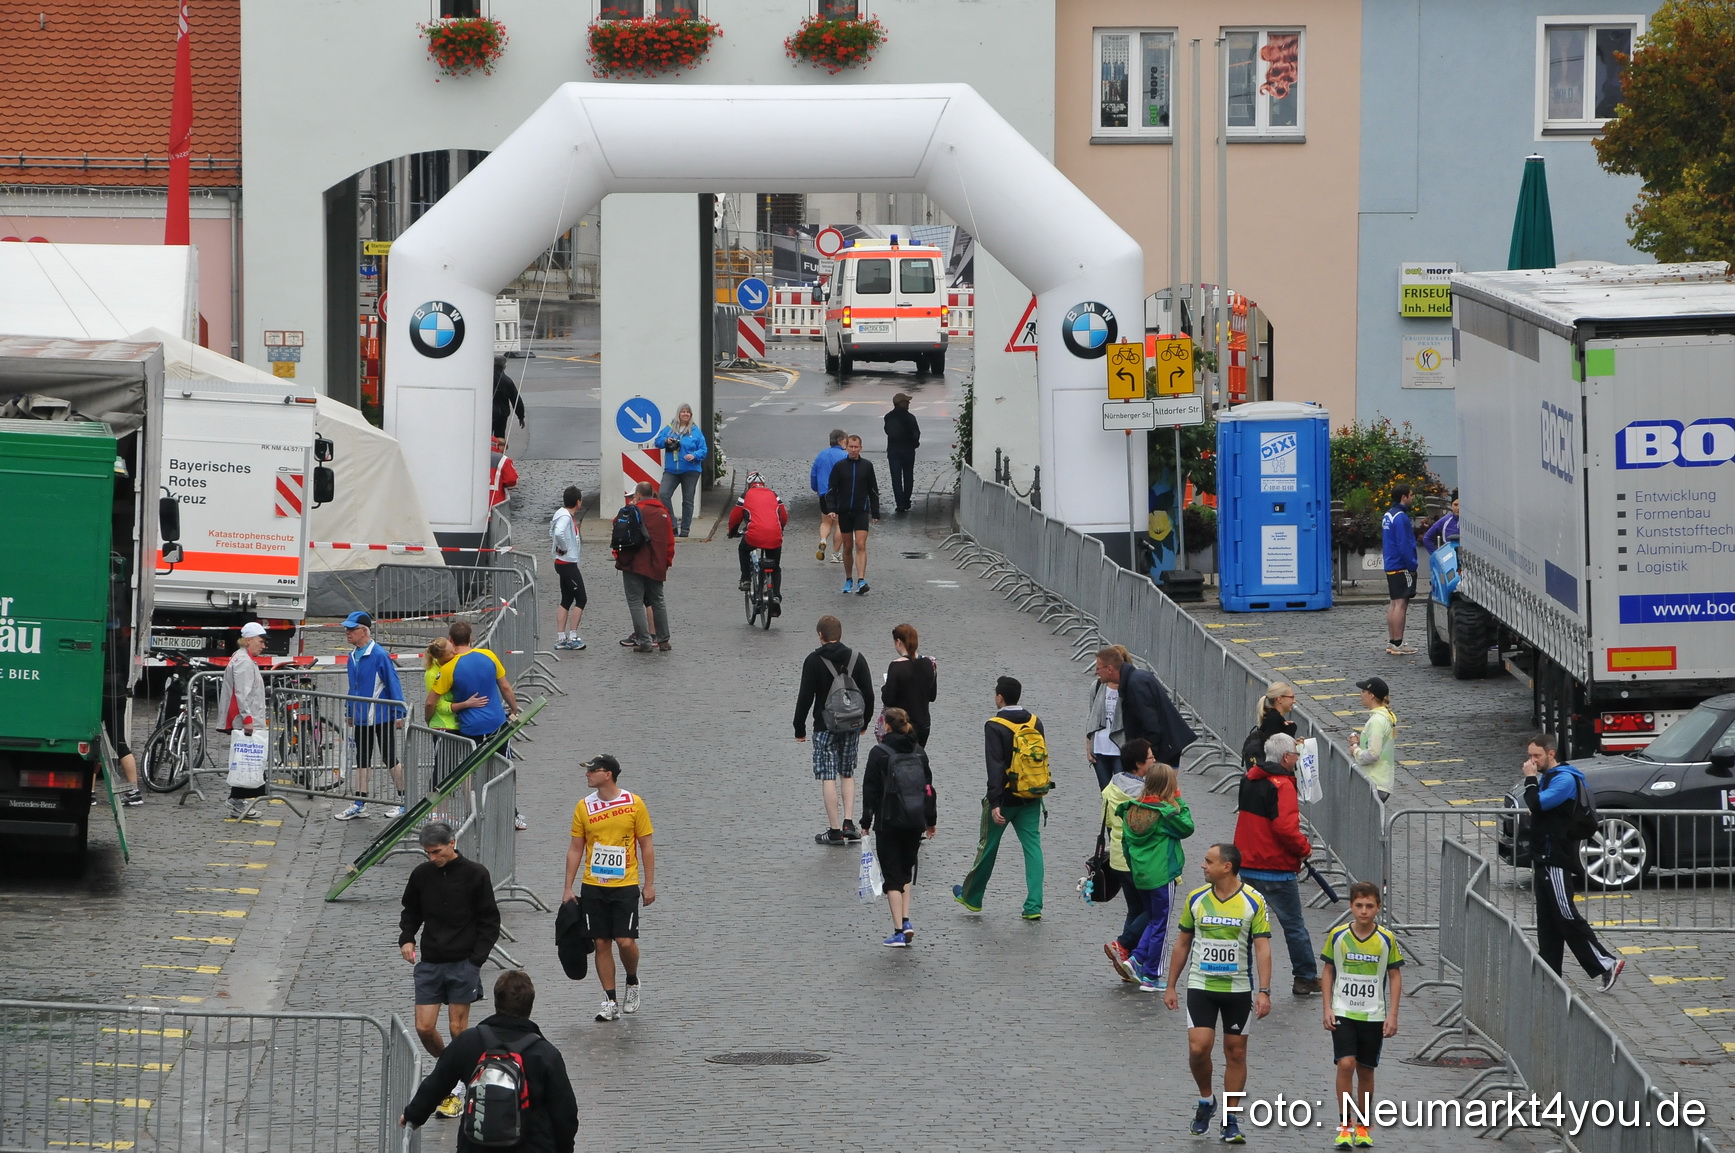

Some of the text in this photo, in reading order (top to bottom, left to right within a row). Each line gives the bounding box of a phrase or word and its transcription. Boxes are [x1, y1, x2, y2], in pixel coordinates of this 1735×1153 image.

[1149, 105, 1158, 125] cut
[1405, 267, 1423, 275] cut
[415, 301, 461, 322] BMW
[1067, 302, 1113, 322] BMW
[1404, 304, 1425, 312] Inh.
[1105, 412, 1141, 420] Nürnberger
[1155, 405, 1202, 415] Altdorfer Str.
[1540, 400, 1574, 484] BOCK
[169, 459, 251, 474] Bayerisches
[168, 475, 207, 488] Rotes
[170, 492, 206, 505] reuz
[1635, 489, 1716, 503] Entwicklung
[1635, 507, 1711, 520] Formenbau
[208, 530, 295, 542] Katastrophenschutz
[1636, 523, 1735, 538] Kunststofftech
[215, 540, 286, 552] Freistaat Bayern
[1367, 557, 1382, 567] Café
[1637, 560, 1688, 575] Logistik
[152, 637, 201, 648] NM RK 8009
[9, 668, 40, 680] BIER
[9, 800, 57, 809] Mercedes-Benz
[589, 807, 636, 825] MAX BÖGL
[594, 852, 623, 867] 2780
[1201, 915, 1243, 927] BOCK
[1203, 947, 1236, 962] 2906
[1345, 952, 1381, 964] BOCK
[1341, 983, 1375, 998] 4049
